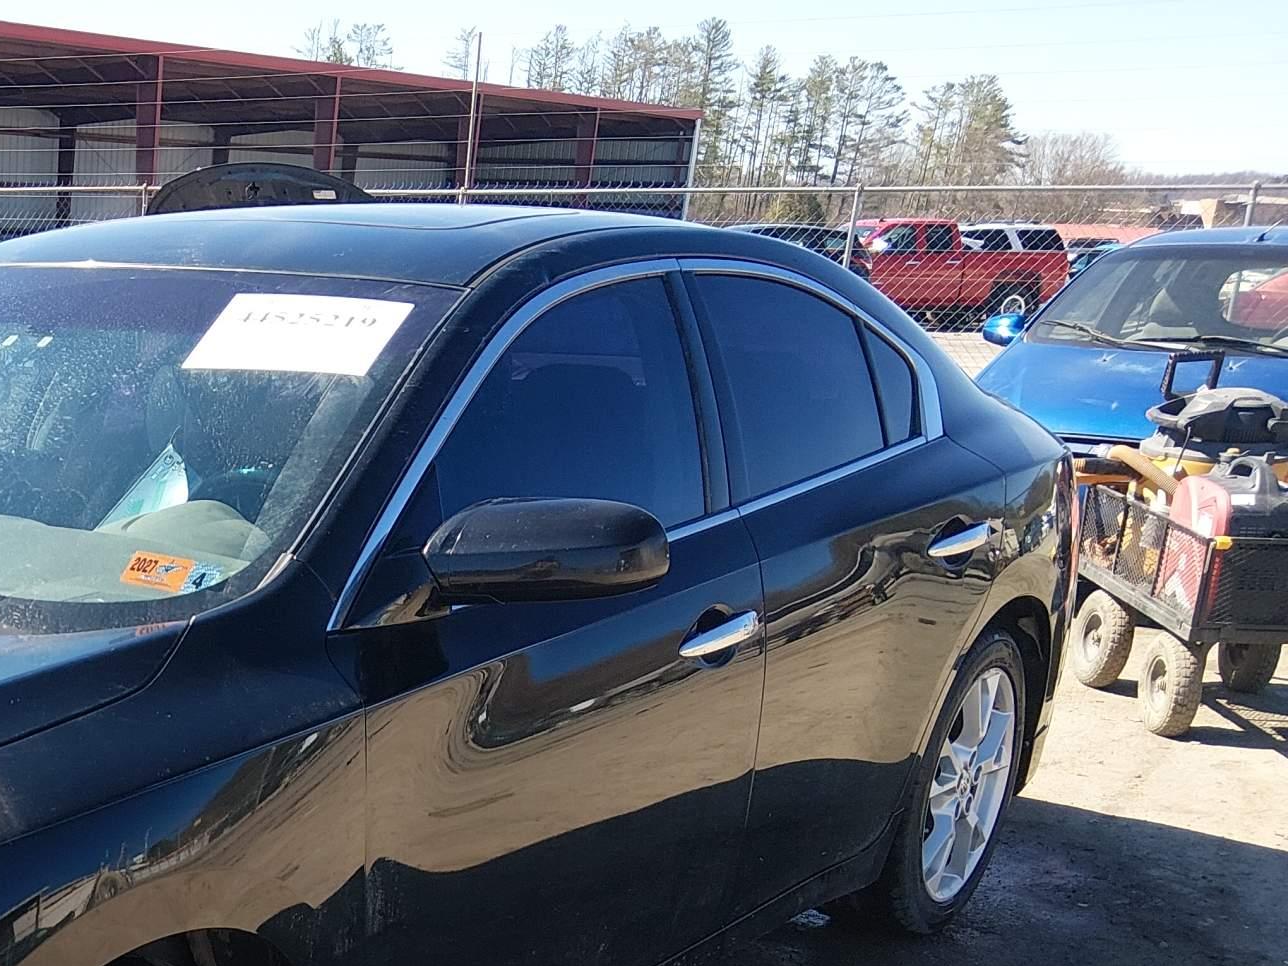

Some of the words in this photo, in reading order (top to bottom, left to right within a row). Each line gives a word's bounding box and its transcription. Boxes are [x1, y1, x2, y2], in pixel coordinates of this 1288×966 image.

[238, 310, 378, 328] 44525219
[129, 556, 159, 574] 2027
[192, 572, 207, 589] 4
